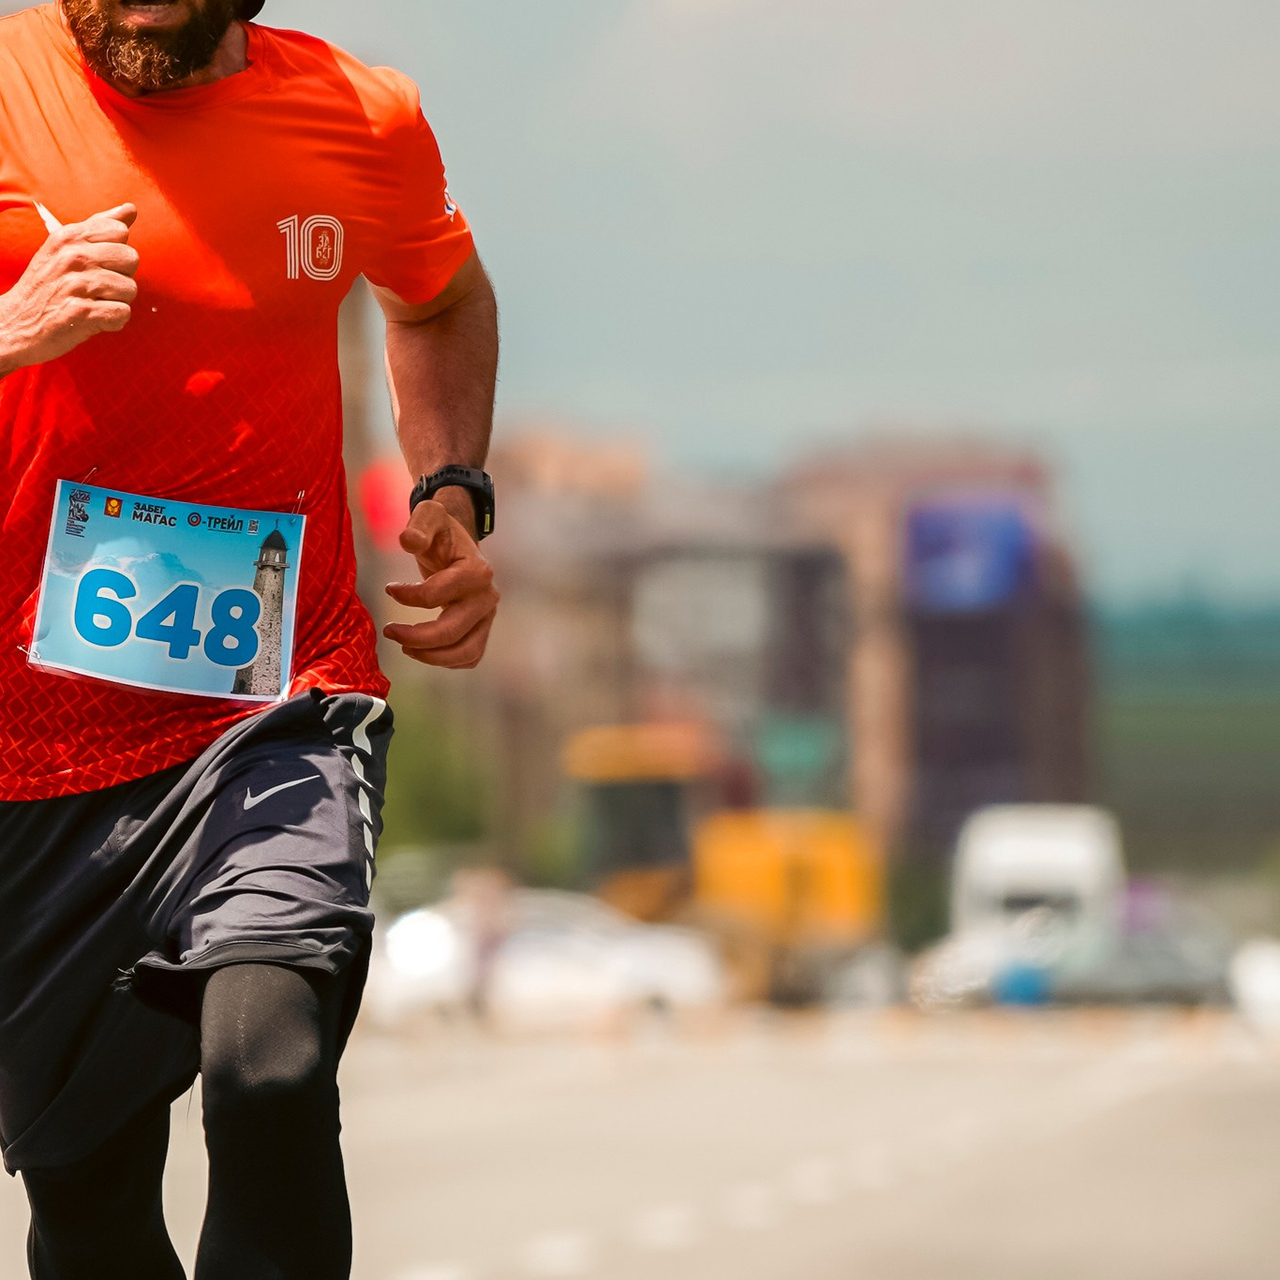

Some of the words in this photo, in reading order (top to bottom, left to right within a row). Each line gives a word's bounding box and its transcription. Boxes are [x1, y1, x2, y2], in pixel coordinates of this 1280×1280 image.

[276, 214, 344, 281] 10
[132, 510, 177, 527] МАГАС
[133, 502, 166, 514] ЗАБЕГ
[73, 567, 261, 667] 648
